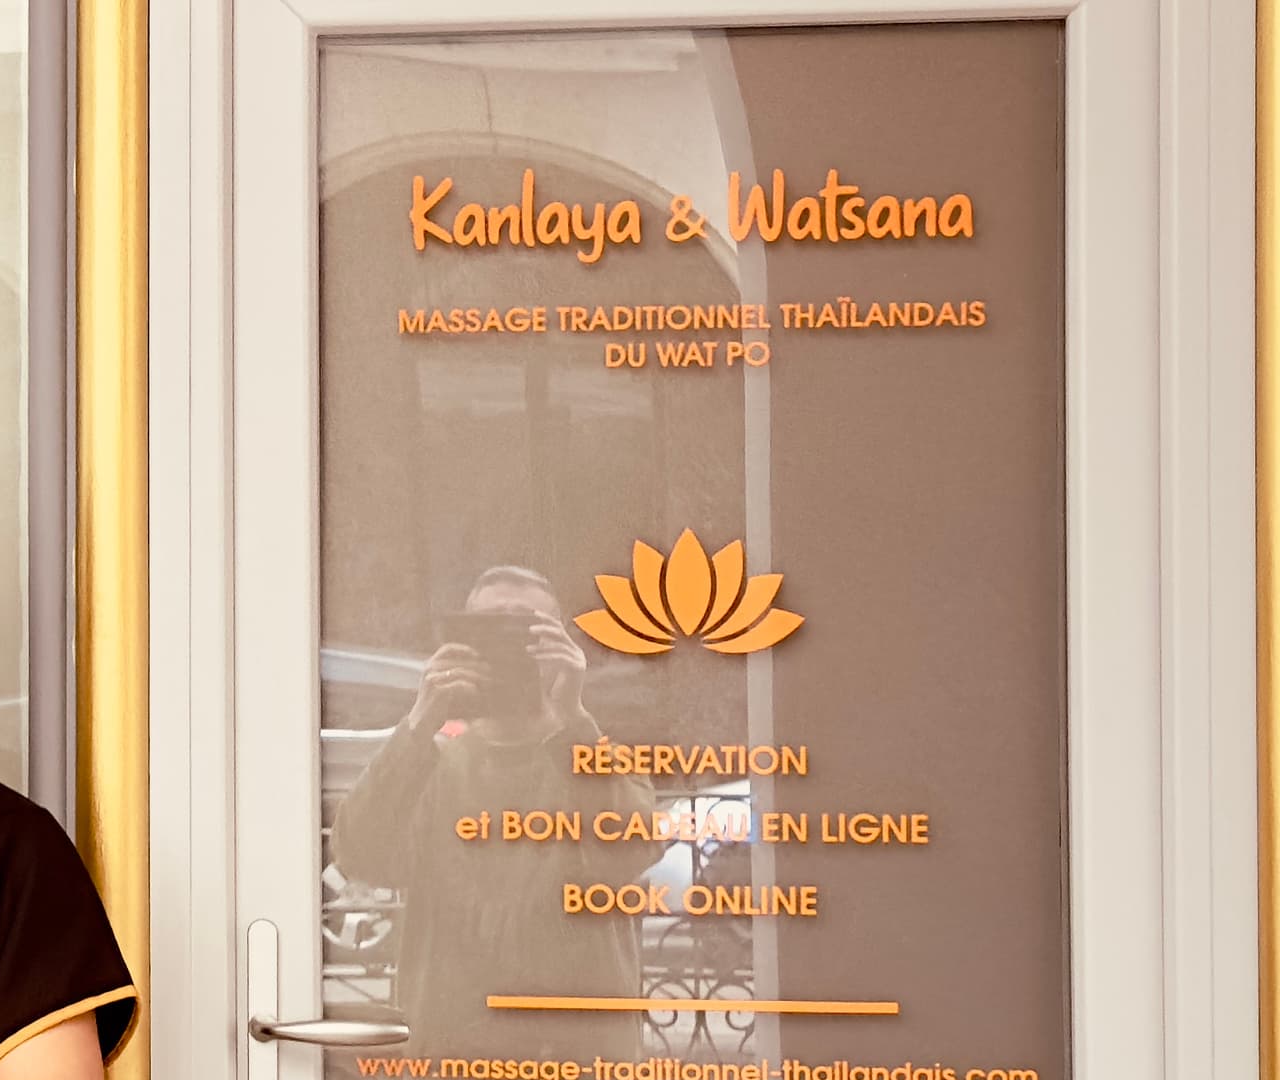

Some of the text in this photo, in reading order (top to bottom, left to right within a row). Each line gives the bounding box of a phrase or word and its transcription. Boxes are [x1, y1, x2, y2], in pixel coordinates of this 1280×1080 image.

[408, 167, 974, 264] Kanlaya & Watsana
[398, 296, 986, 334] MASSAGE TRADITIONNEL THAÏLANDAIS
[605, 340, 771, 368] DU WAT PO
[572, 735, 808, 777] RÉSERVATION
[455, 810, 930, 845] et BON CADEAU EN LIGNE
[563, 883, 818, 916] BOOK ONLINE
